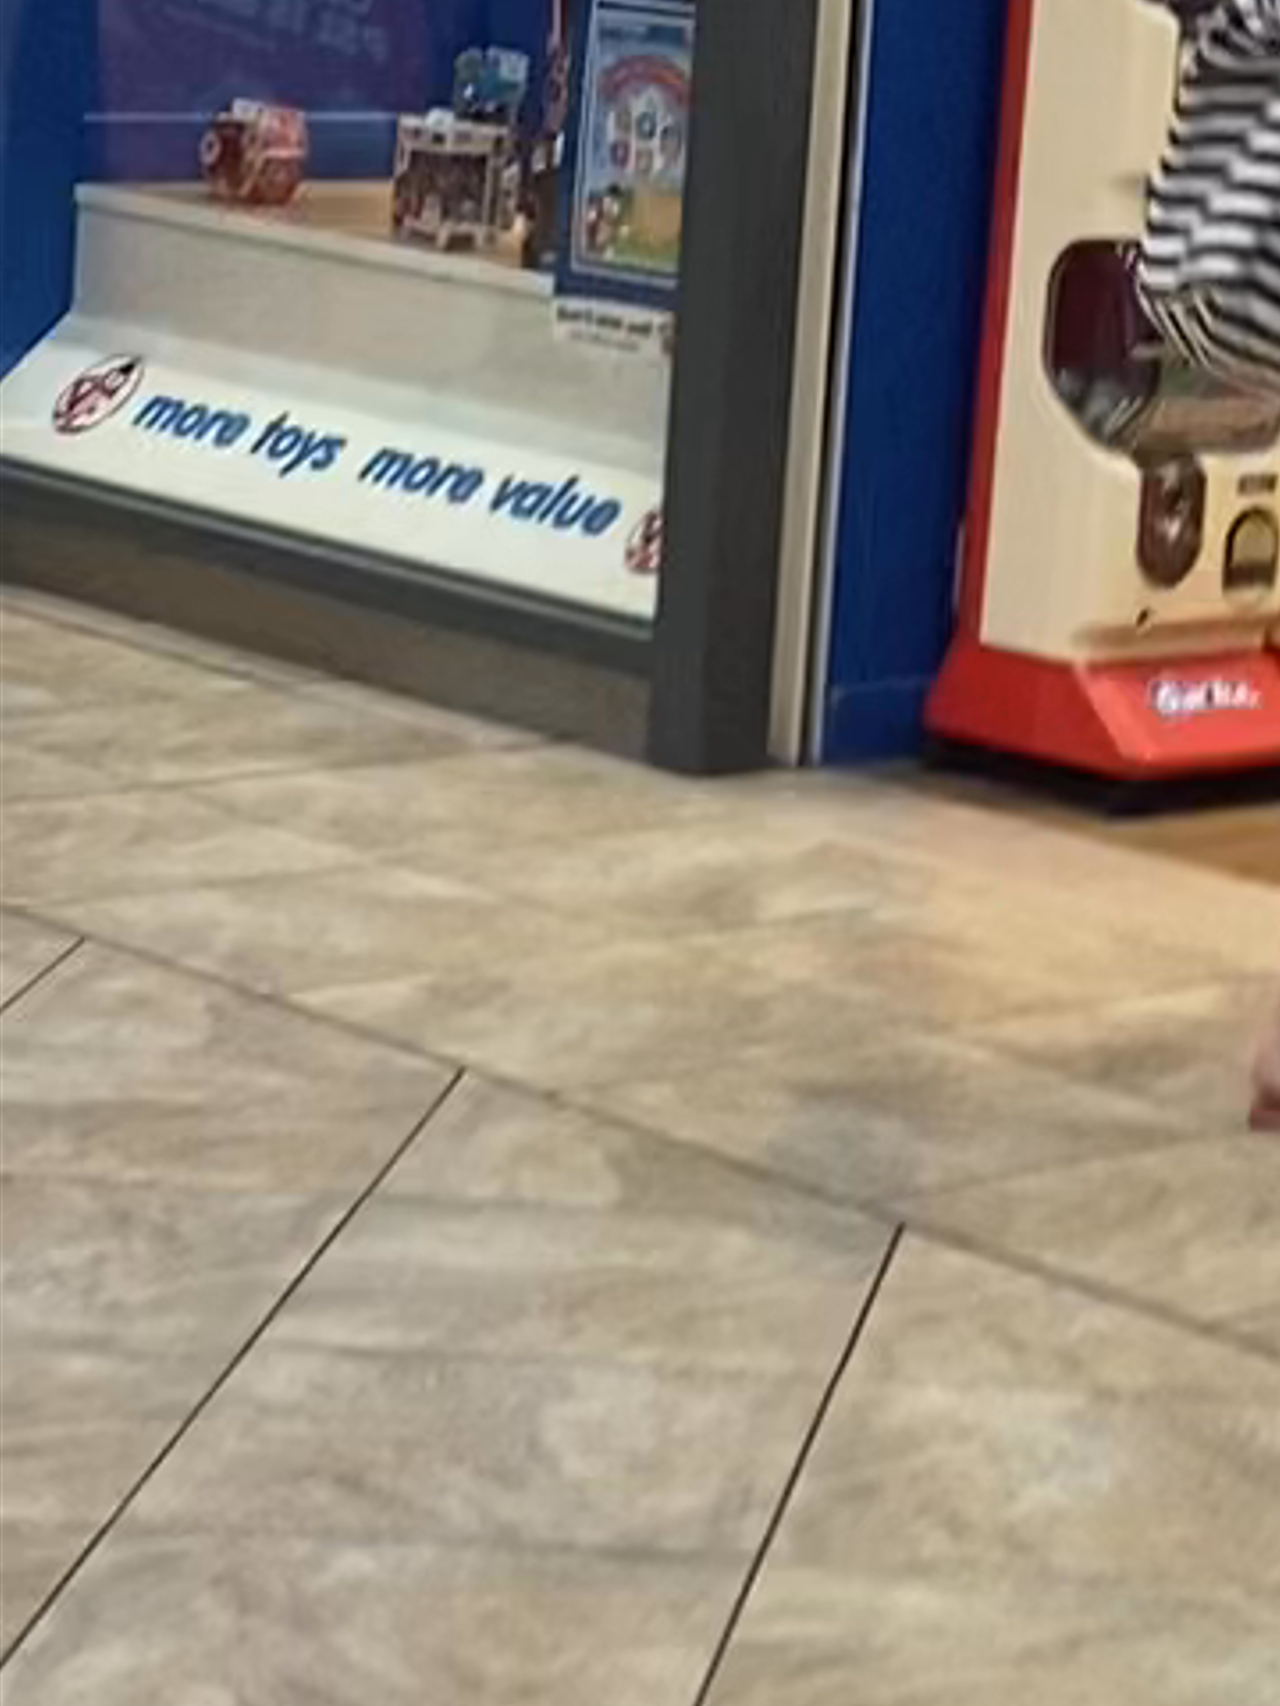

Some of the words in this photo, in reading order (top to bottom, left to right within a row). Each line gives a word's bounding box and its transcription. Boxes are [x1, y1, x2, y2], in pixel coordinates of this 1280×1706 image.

[133, 393, 251, 448] more
[250, 410, 348, 479] toys
[357, 443, 485, 504] more
[488, 472, 624, 539] value
